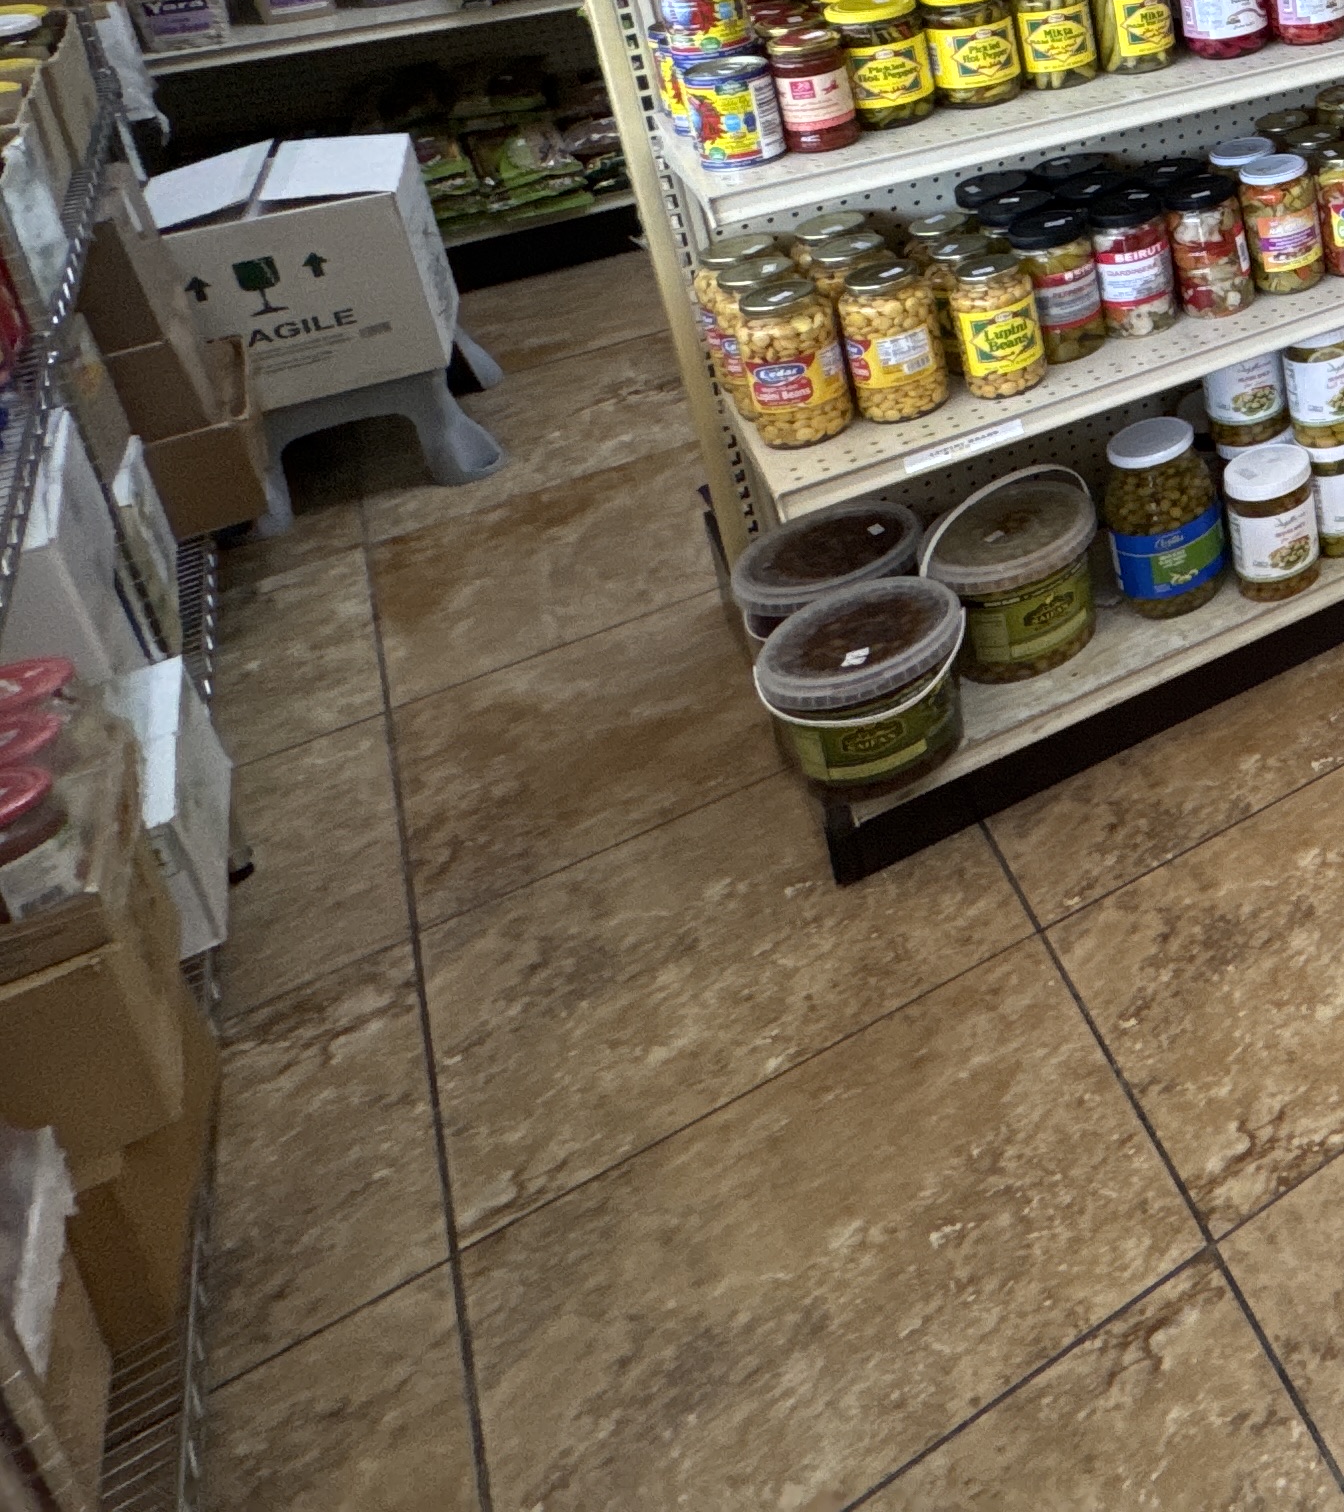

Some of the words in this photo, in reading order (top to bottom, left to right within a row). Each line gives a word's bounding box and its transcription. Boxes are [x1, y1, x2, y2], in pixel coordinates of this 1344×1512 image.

[968, 41, 1001, 55] Pickled
[962, 52, 979, 64] Hot
[858, 72, 881, 84] Hot
[882, 66, 919, 81] Pepper
[867, 61, 906, 75] Pickled
[1114, 245, 1163, 264] BEIRUT
[247, 308, 359, 348] AGILE
[984, 319, 1028, 342] Lupini
[988, 335, 1030, 355] Beans
[758, 366, 805, 384] Cedar
[782, 387, 811, 400] Beans
